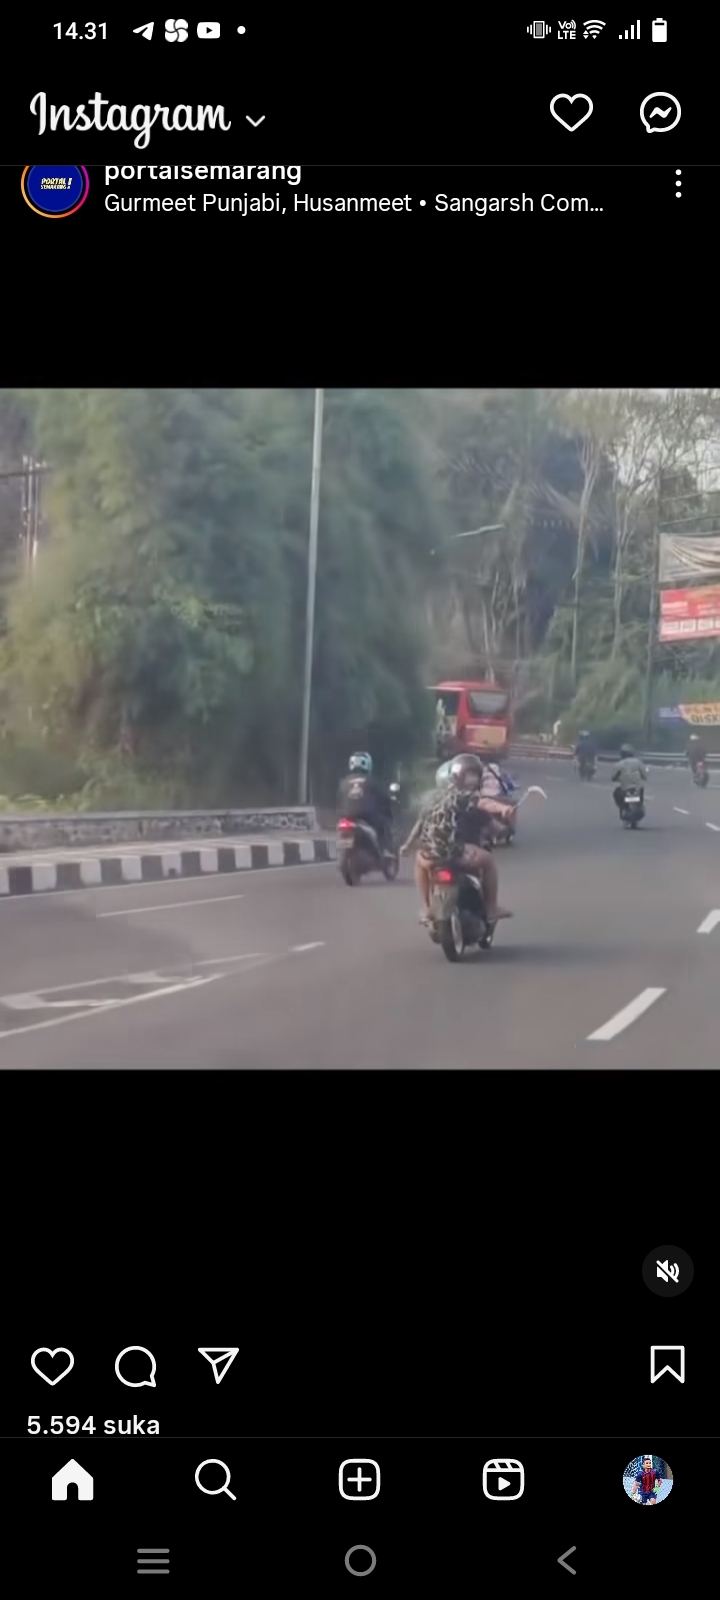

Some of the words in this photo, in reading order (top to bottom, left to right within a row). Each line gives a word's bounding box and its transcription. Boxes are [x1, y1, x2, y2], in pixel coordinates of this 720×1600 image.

[53, 21, 107, 40] 14.31
[557, 30, 576, 39] LTE
[29, 91, 232, 149] Instagram
[105, 166, 302, 186] portalsemarang
[104, 193, 197, 212] Gurmeet
[203, 192, 287, 217] Punjabi,
[294, 193, 413, 212] Husanmeet
[434, 192, 534, 217] Sangarsh
[26, 1415, 97, 1435] 5.594
[103, 1414, 160, 1435] suka
